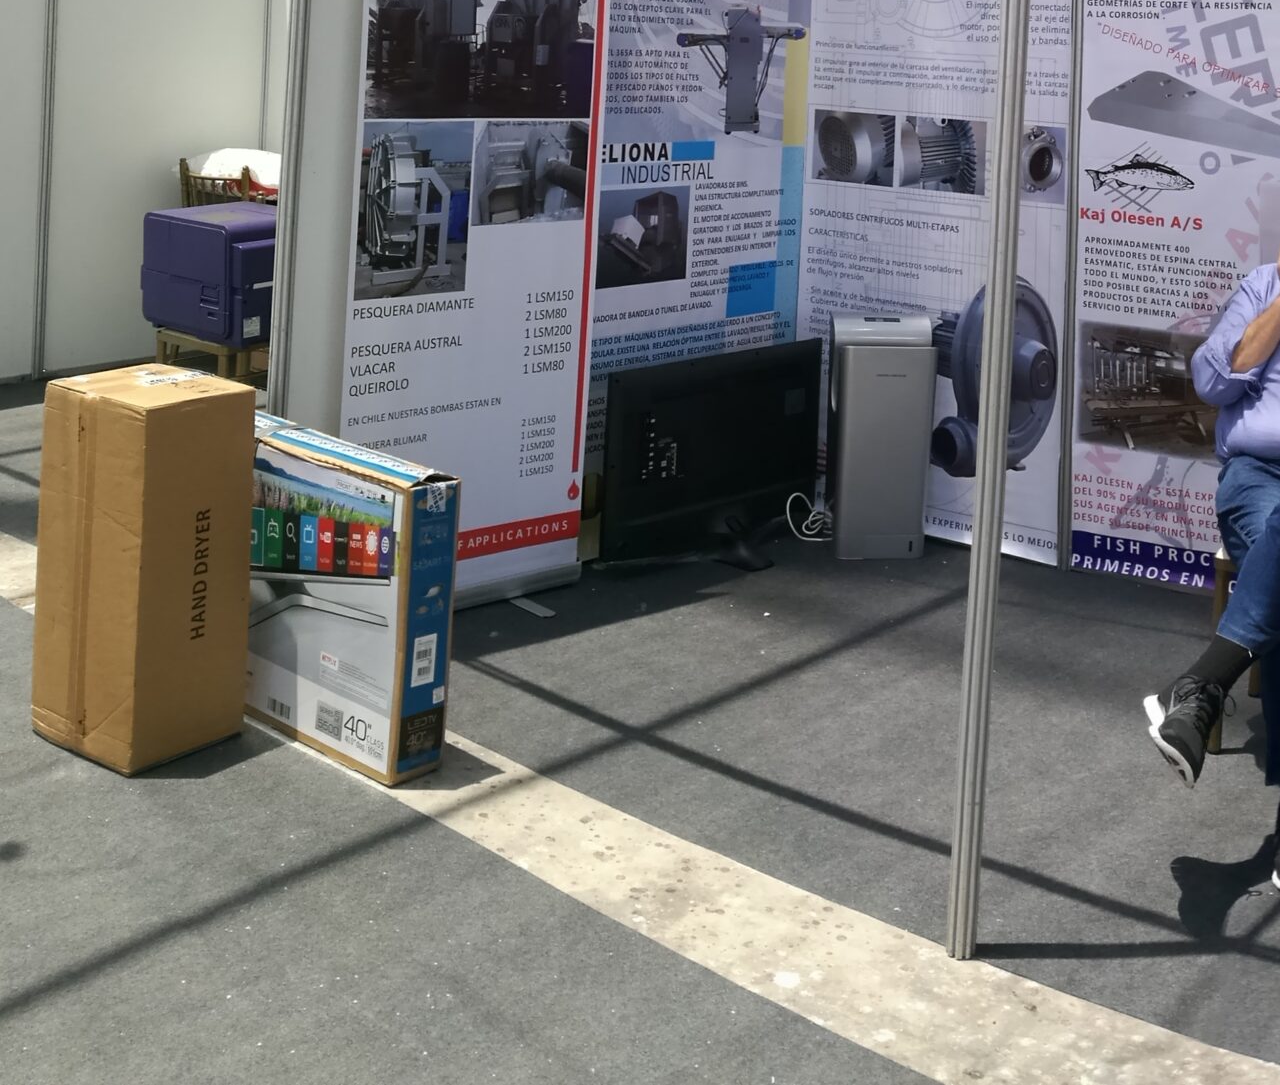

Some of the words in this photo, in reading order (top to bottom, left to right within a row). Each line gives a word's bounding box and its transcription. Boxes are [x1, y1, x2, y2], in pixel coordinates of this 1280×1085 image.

[1166, 47, 1197, 67] PARA
[1202, 61, 1270, 94] OPTIMIZAR
[601, 142, 669, 163] LIONA
[621, 162, 714, 185] INDUSTRIAL
[809, 208, 855, 221] SOPLADORES
[855, 213, 905, 227] CENTRIFUGOS
[906, 219, 960, 234] MULTI-ETAPAS
[1079, 207, 1105, 224] Kaj
[1110, 210, 1165, 227] Olesen
[1170, 216, 1203, 232] A/S
[1084, 235, 1171, 252] APROXIMADAMENTE
[1174, 244, 1190, 254] 400
[526, 293, 532, 304] 1
[534, 289, 574, 303] LSM150
[353, 303, 414, 320] PESQUERA
[416, 297, 475, 314] DIAMANTE
[525, 310, 531, 322] 2
[534, 307, 568, 321] LSM80
[1082, 300, 1121, 312] SERVICIO
[1124, 305, 1134, 314] DE
[1137, 306, 1180, 319] PRIMERA.
[524, 328, 530, 339] 1
[533, 324, 572, 338] LSM200
[351, 341, 412, 358] PESQUERA
[414, 335, 463, 352] AUSTRAL
[524, 345, 530, 357] 2
[532, 341, 572, 356] LSM150
[350, 361, 396, 378] VLACAR
[523, 363, 529, 374] 1
[531, 360, 565, 374] LSM80
[349, 378, 410, 398] QUEIROLO
[348, 417, 359, 427] EN
[361, 413, 386, 425] CHILE
[387, 406, 429, 421] NUESTRAS
[430, 401, 464, 415] BOMBAS
[465, 398, 490, 410] ESTAN
[491, 396, 501, 406] EN
[393, 433, 427, 447] BLUMAR
[193, 508, 212, 576] DRYER
[467, 520, 568, 549] APPLICATIONS
[1093, 535, 1140, 555] FISH
[1071, 553, 1171, 582] PRIMEROS
[1179, 572, 1206, 588] EN
[190, 579, 208, 641] HAND
[366, 735, 384, 751] CLASS
